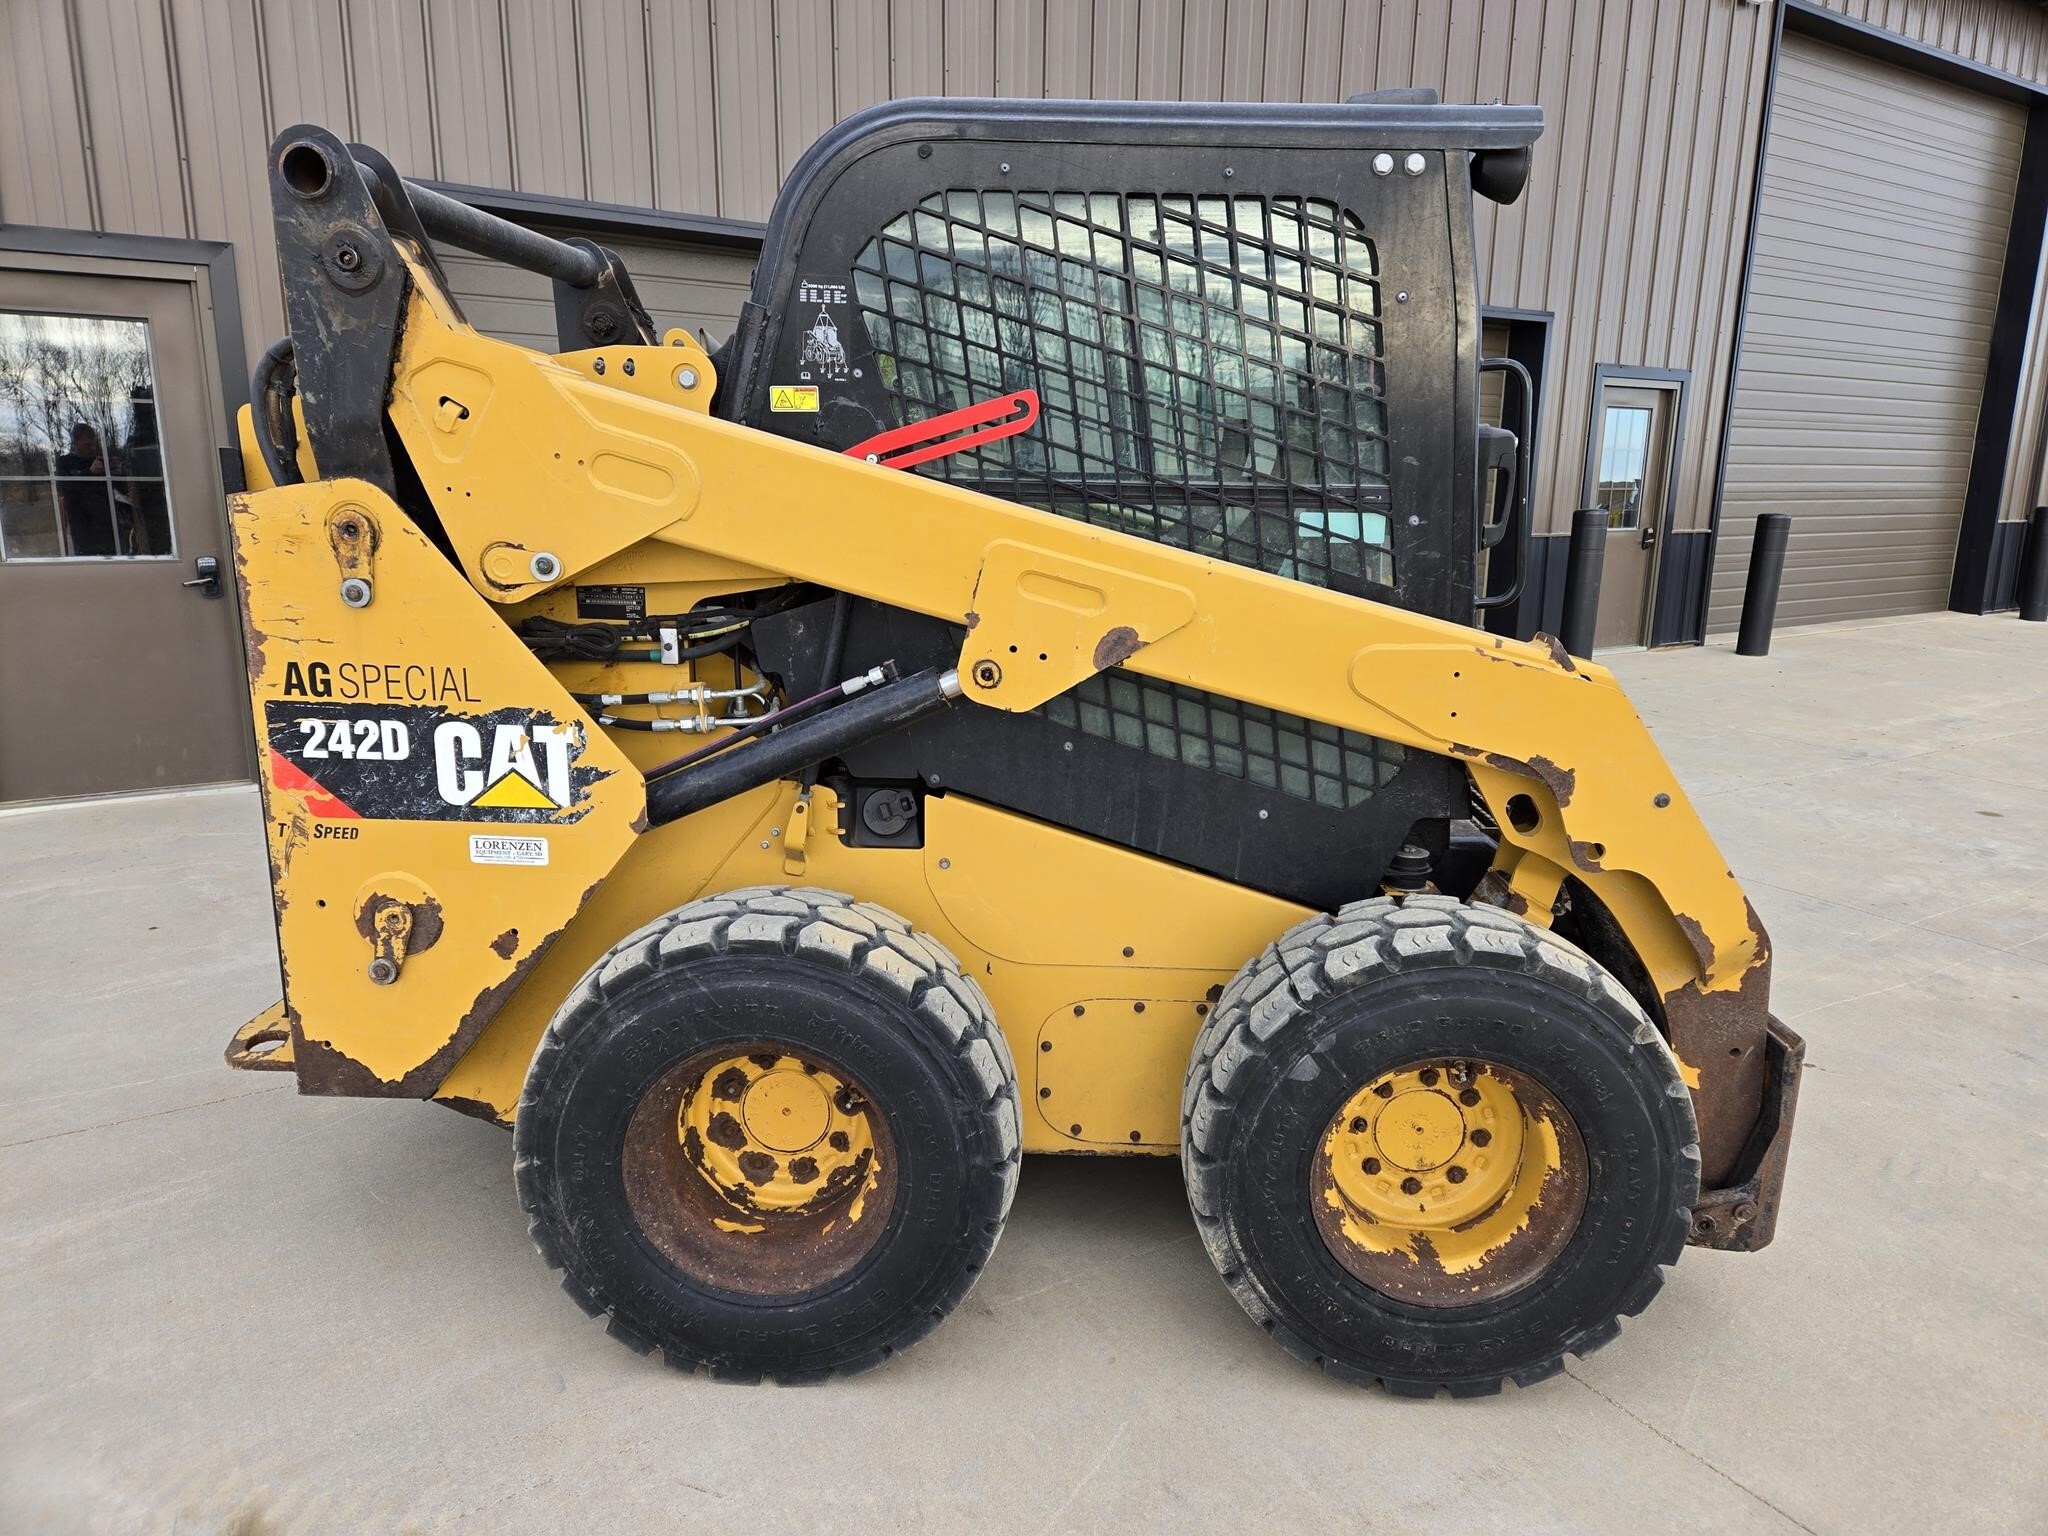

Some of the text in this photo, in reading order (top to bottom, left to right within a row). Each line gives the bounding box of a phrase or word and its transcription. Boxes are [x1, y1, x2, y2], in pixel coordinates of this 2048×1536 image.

[284, 661, 482, 702] AG SPECIAL
[299, 719, 410, 761] 242D
[433, 721, 579, 809] CAT
[474, 840, 543, 852] LORENZEN
